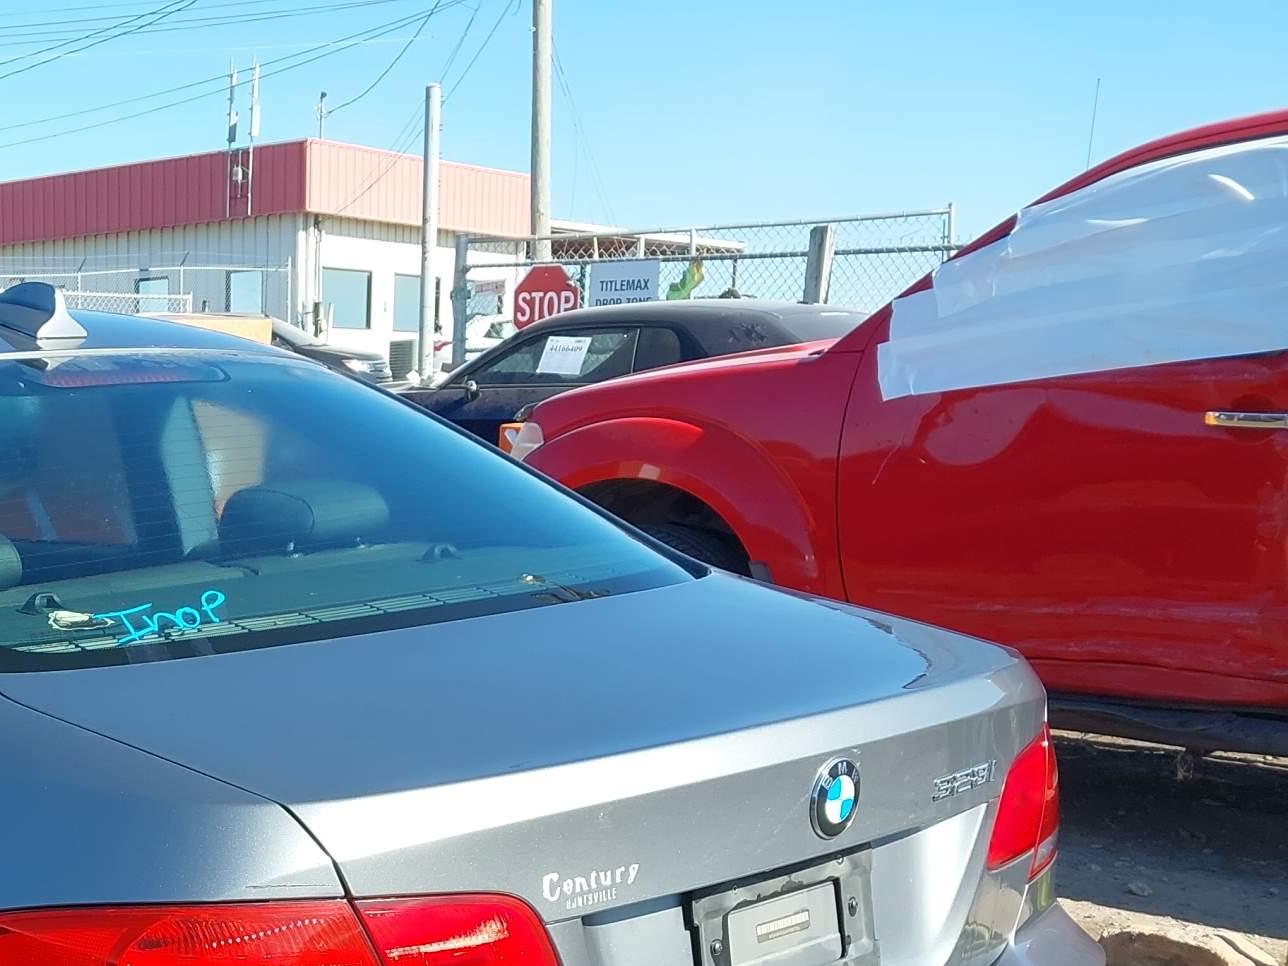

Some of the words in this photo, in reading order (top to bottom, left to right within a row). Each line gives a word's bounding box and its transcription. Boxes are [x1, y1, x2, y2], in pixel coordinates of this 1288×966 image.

[599, 278, 650, 292] TITLEMAX
[516, 290, 575, 322] STOP
[542, 863, 640, 902] Century
[565, 887, 617, 910] HUNTSVILLE
